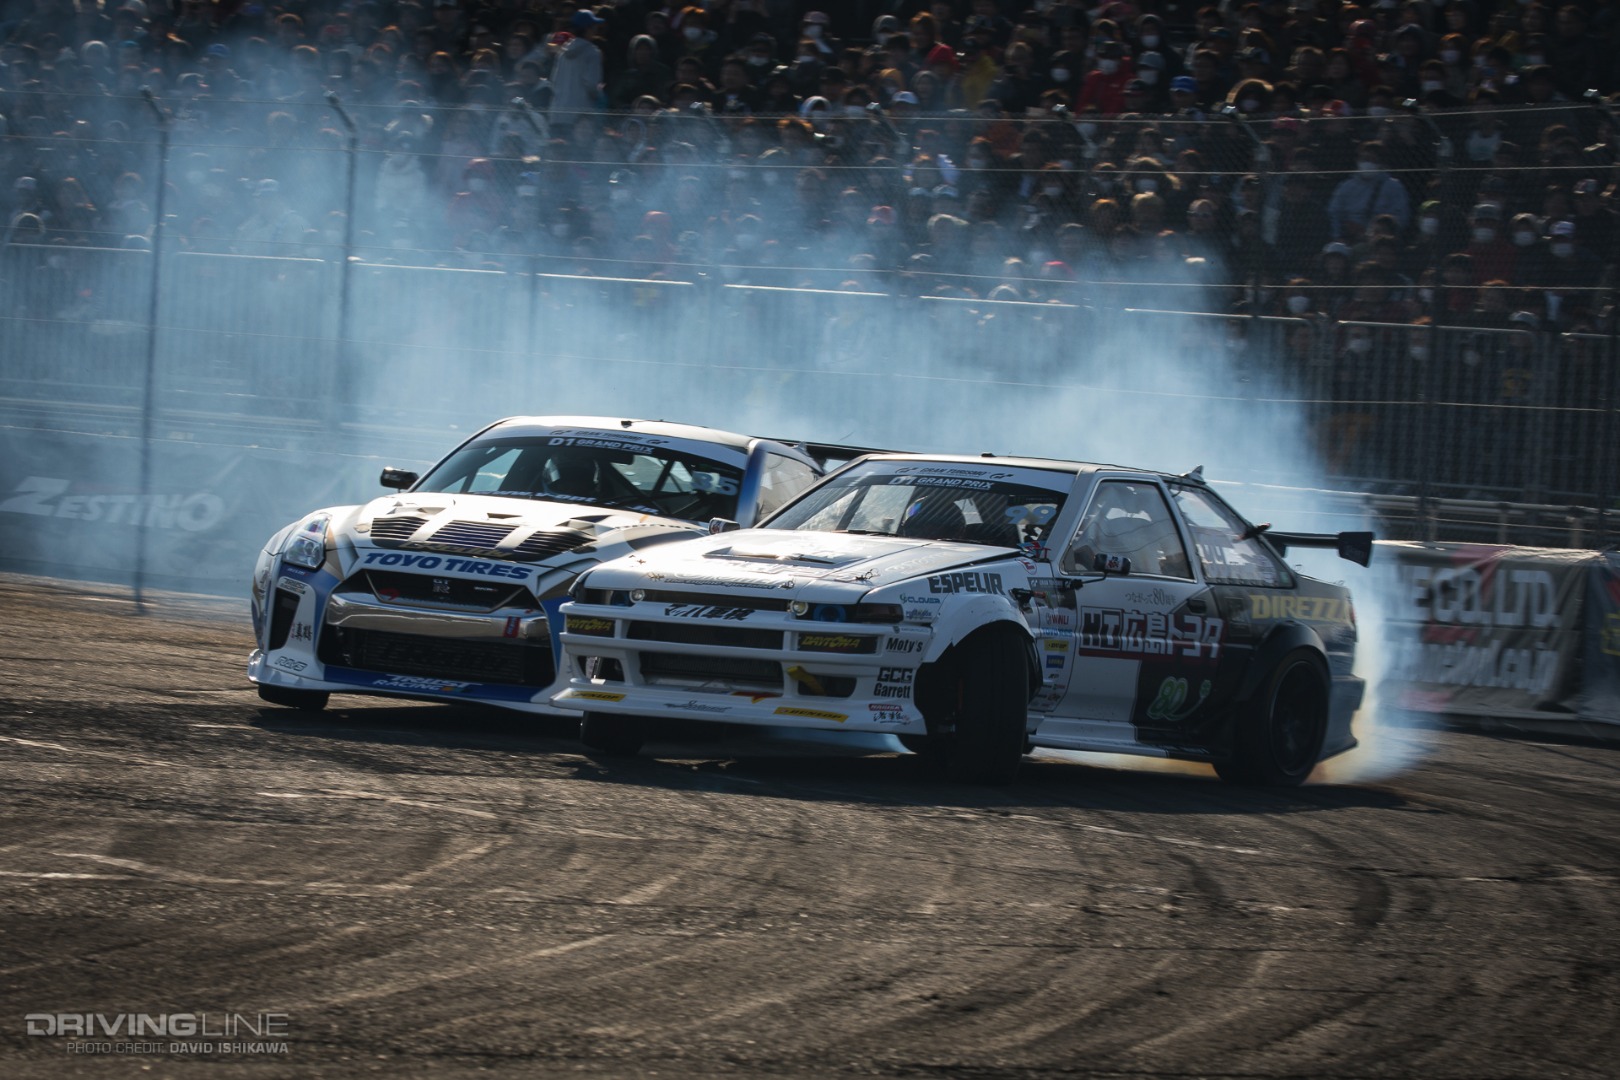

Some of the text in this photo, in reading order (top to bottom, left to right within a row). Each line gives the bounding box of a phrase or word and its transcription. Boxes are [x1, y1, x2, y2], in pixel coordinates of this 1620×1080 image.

[548, 437, 655, 454] D1 GRAND PRIX
[919, 466, 988, 477] GRAN TURISMO
[889, 475, 993, 490] D1 GRAND PRIX
[0, 476, 225, 532] ZESTINO
[1005, 505, 1057, 525] 99
[364, 552, 533, 580] TOYO TIRES
[927, 571, 1006, 596] ESPELIR
[907, 596, 941, 604] CLOVER
[800, 635, 861, 649] DAYTONA
[885, 637, 924, 652] Moty's
[385, 673, 483, 689] TRUST
[877, 667, 914, 683] GCG
[372, 679, 443, 692] RACING
[874, 682, 911, 699] Garrett
[1146, 676, 1189, 721] 80
